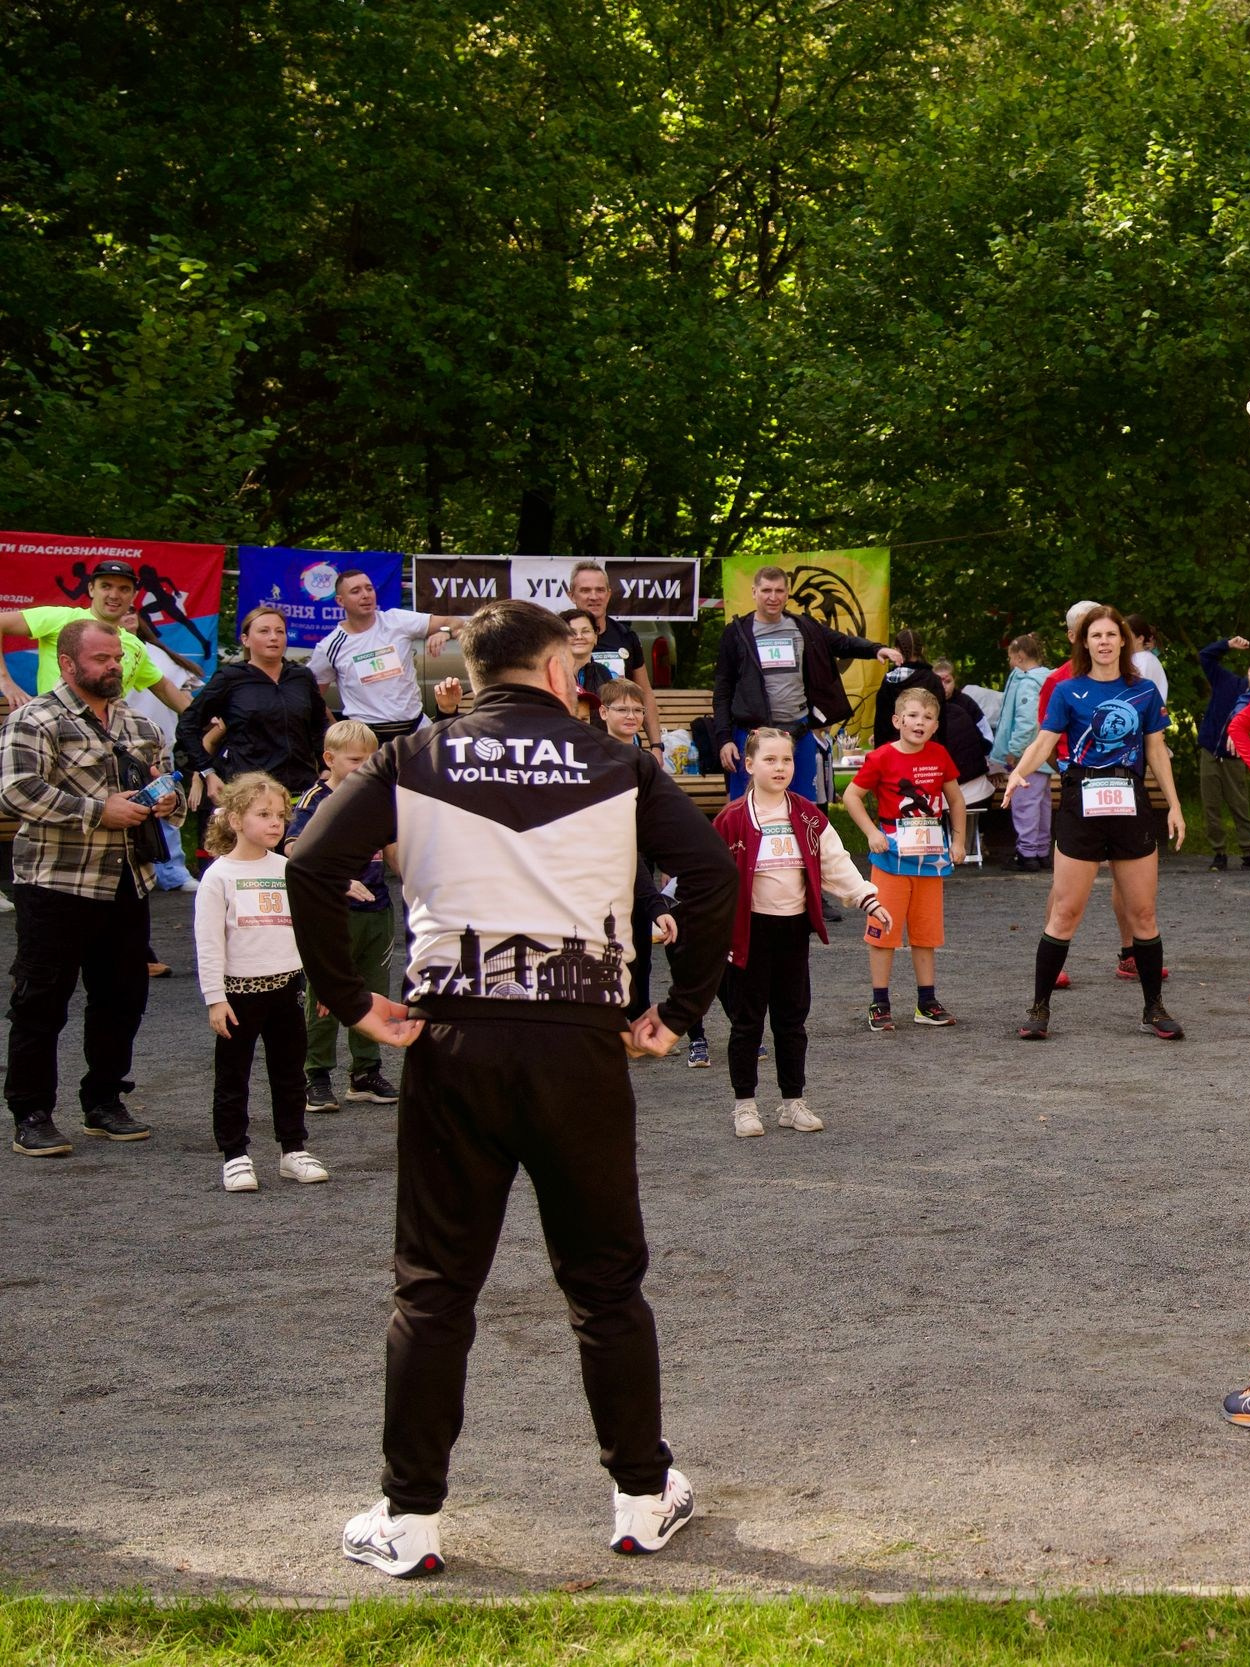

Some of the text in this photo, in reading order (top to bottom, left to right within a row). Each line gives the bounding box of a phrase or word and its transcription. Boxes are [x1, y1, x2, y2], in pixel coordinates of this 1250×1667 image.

[18, 544, 143, 558] КРАСНОЗНАМЕНСК
[432, 577, 497, 598] УГЛИ
[526, 578, 570, 598] УГЛ
[620, 578, 681, 599] УГЛИ
[322, 607, 347, 620] СП
[768, 647, 781, 659] 14
[369, 658, 385, 672] 16
[447, 766, 590, 785] VOLLEYBALL
[1096, 789, 1123, 805] 168
[915, 828, 931, 844] 21
[771, 837, 794, 856] 34
[259, 892, 283, 913] 53
